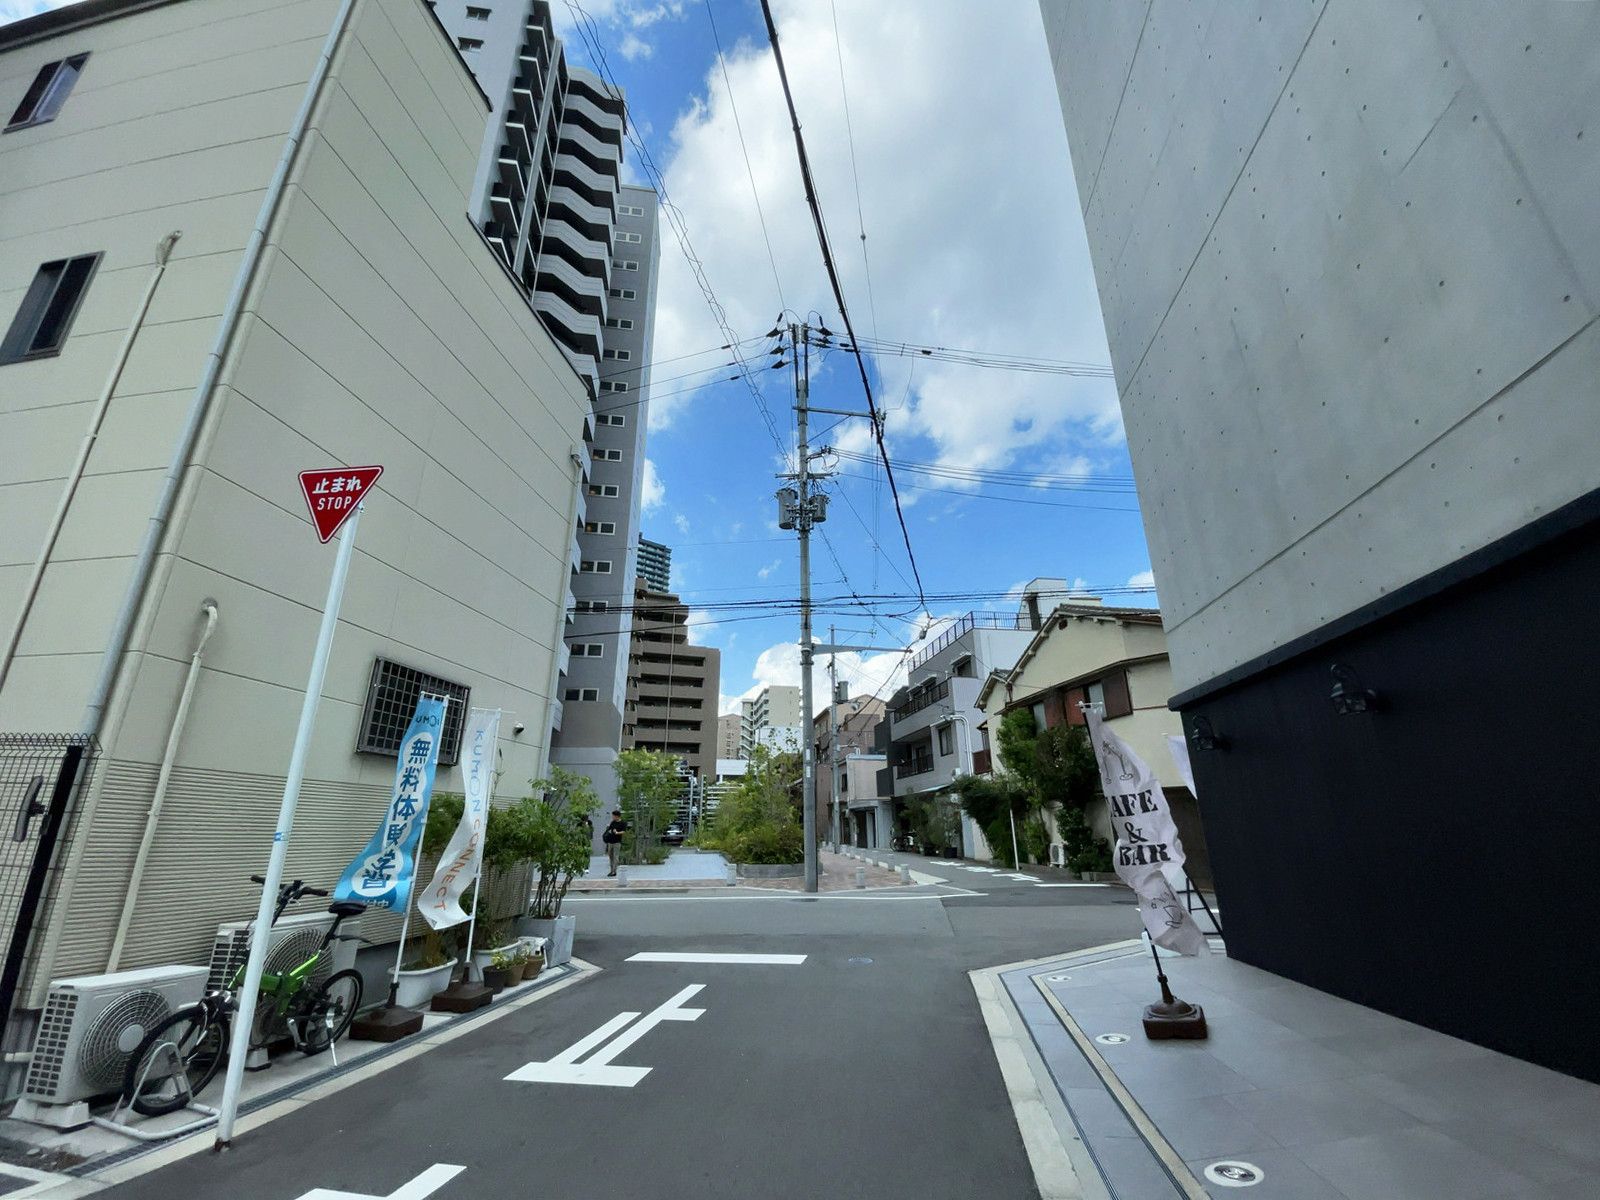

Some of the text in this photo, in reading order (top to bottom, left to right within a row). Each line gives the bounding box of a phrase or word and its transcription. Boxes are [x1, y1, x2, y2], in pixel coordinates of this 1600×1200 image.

[312, 475, 362, 494] 止まれ
[317, 496, 352, 510] STOP
[1106, 789, 1158, 818] AFE
[433, 730, 484, 911] KUMON CONNECT
[1124, 821, 1149, 844] &
[1119, 843, 1171, 866] BAR
